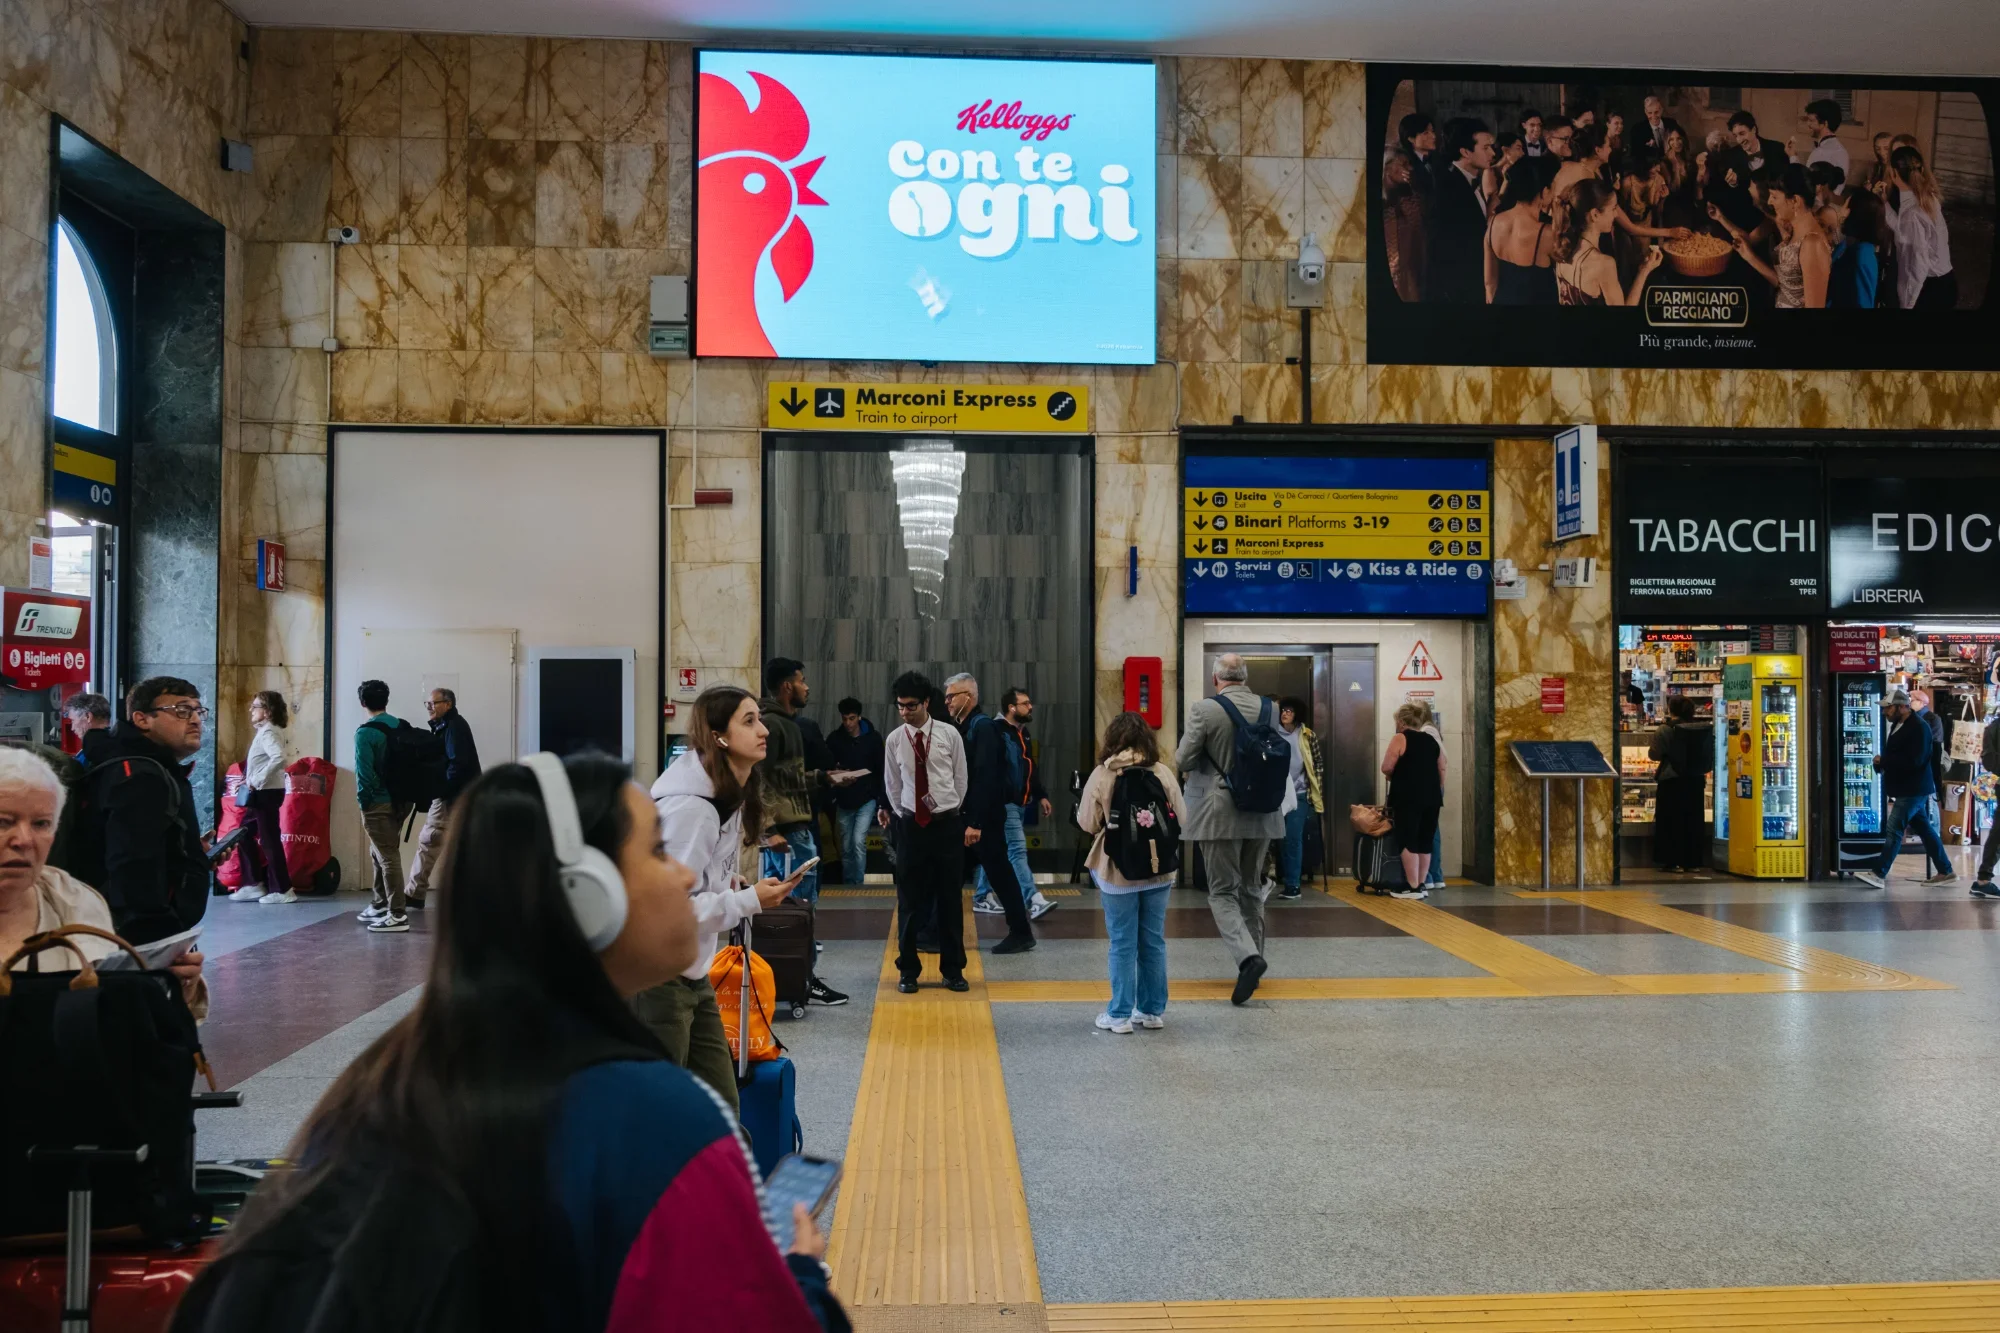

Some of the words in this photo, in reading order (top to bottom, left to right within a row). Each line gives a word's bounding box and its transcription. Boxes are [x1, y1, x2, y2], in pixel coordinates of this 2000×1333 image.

[888, 140, 1001, 180] Con
[1014, 146, 1074, 182] te
[1654, 291, 1739, 305] PARMIGIANO
[1663, 306, 1732, 320] REGGIANO
[1639, 333, 1660, 348] Più
[1664, 335, 1712, 350] grande,
[1714, 335, 1757, 348] insieme.
[856, 388, 946, 407] Marconi
[953, 389, 1037, 411] Express
[855, 409, 889, 424] Train
[893, 411, 907, 425] to
[911, 410, 958, 427] airport
[1234, 491, 1267, 501] Uscita
[1274, 492, 1285, 500] Via
[1297, 492, 1325, 500] Carracci
[1332, 492, 1364, 501] Quartiere
[1366, 493, 1399, 502] Bolognina
[1234, 501, 1247, 509] Exit
[1234, 515, 1282, 528] Binari
[1288, 515, 1347, 528] Platforms
[1353, 515, 1390, 529] 3-19
[1629, 518, 1817, 553] TABACCHI
[1871, 512, 2000, 553] EDIC
[1235, 538, 1280, 548] Marconi
[1282, 538, 1325, 550] Express
[1252, 548, 1260, 556] to
[1261, 548, 1285, 556] airport
[1234, 561, 1271, 571] Servizi
[1369, 563, 1401, 576] Kiss
[1404, 563, 1418, 576] &
[1422, 563, 1458, 577] Ride
[1555, 564, 1570, 581] LOTTO
[1234, 571, 1256, 579] Toilets
[1629, 578, 1676, 587] BIGLIETTERIA
[1676, 578, 1717, 587] REGIONALE
[1789, 578, 1817, 587] SERVIZI
[1630, 588, 1666, 596] FERROVIA
[1666, 588, 1690, 596] DELLO
[1690, 588, 1713, 596] STATO
[1799, 588, 1817, 596] TPER
[1852, 588, 1924, 604] LIBRERIA
[36, 625, 73, 635] TRENITALIA
[1830, 631, 1843, 639] QUI
[1843, 630, 1878, 639] BIGLIETTI
[24, 651, 61, 668] Biglietti
[24, 667, 42, 676] Tickets
